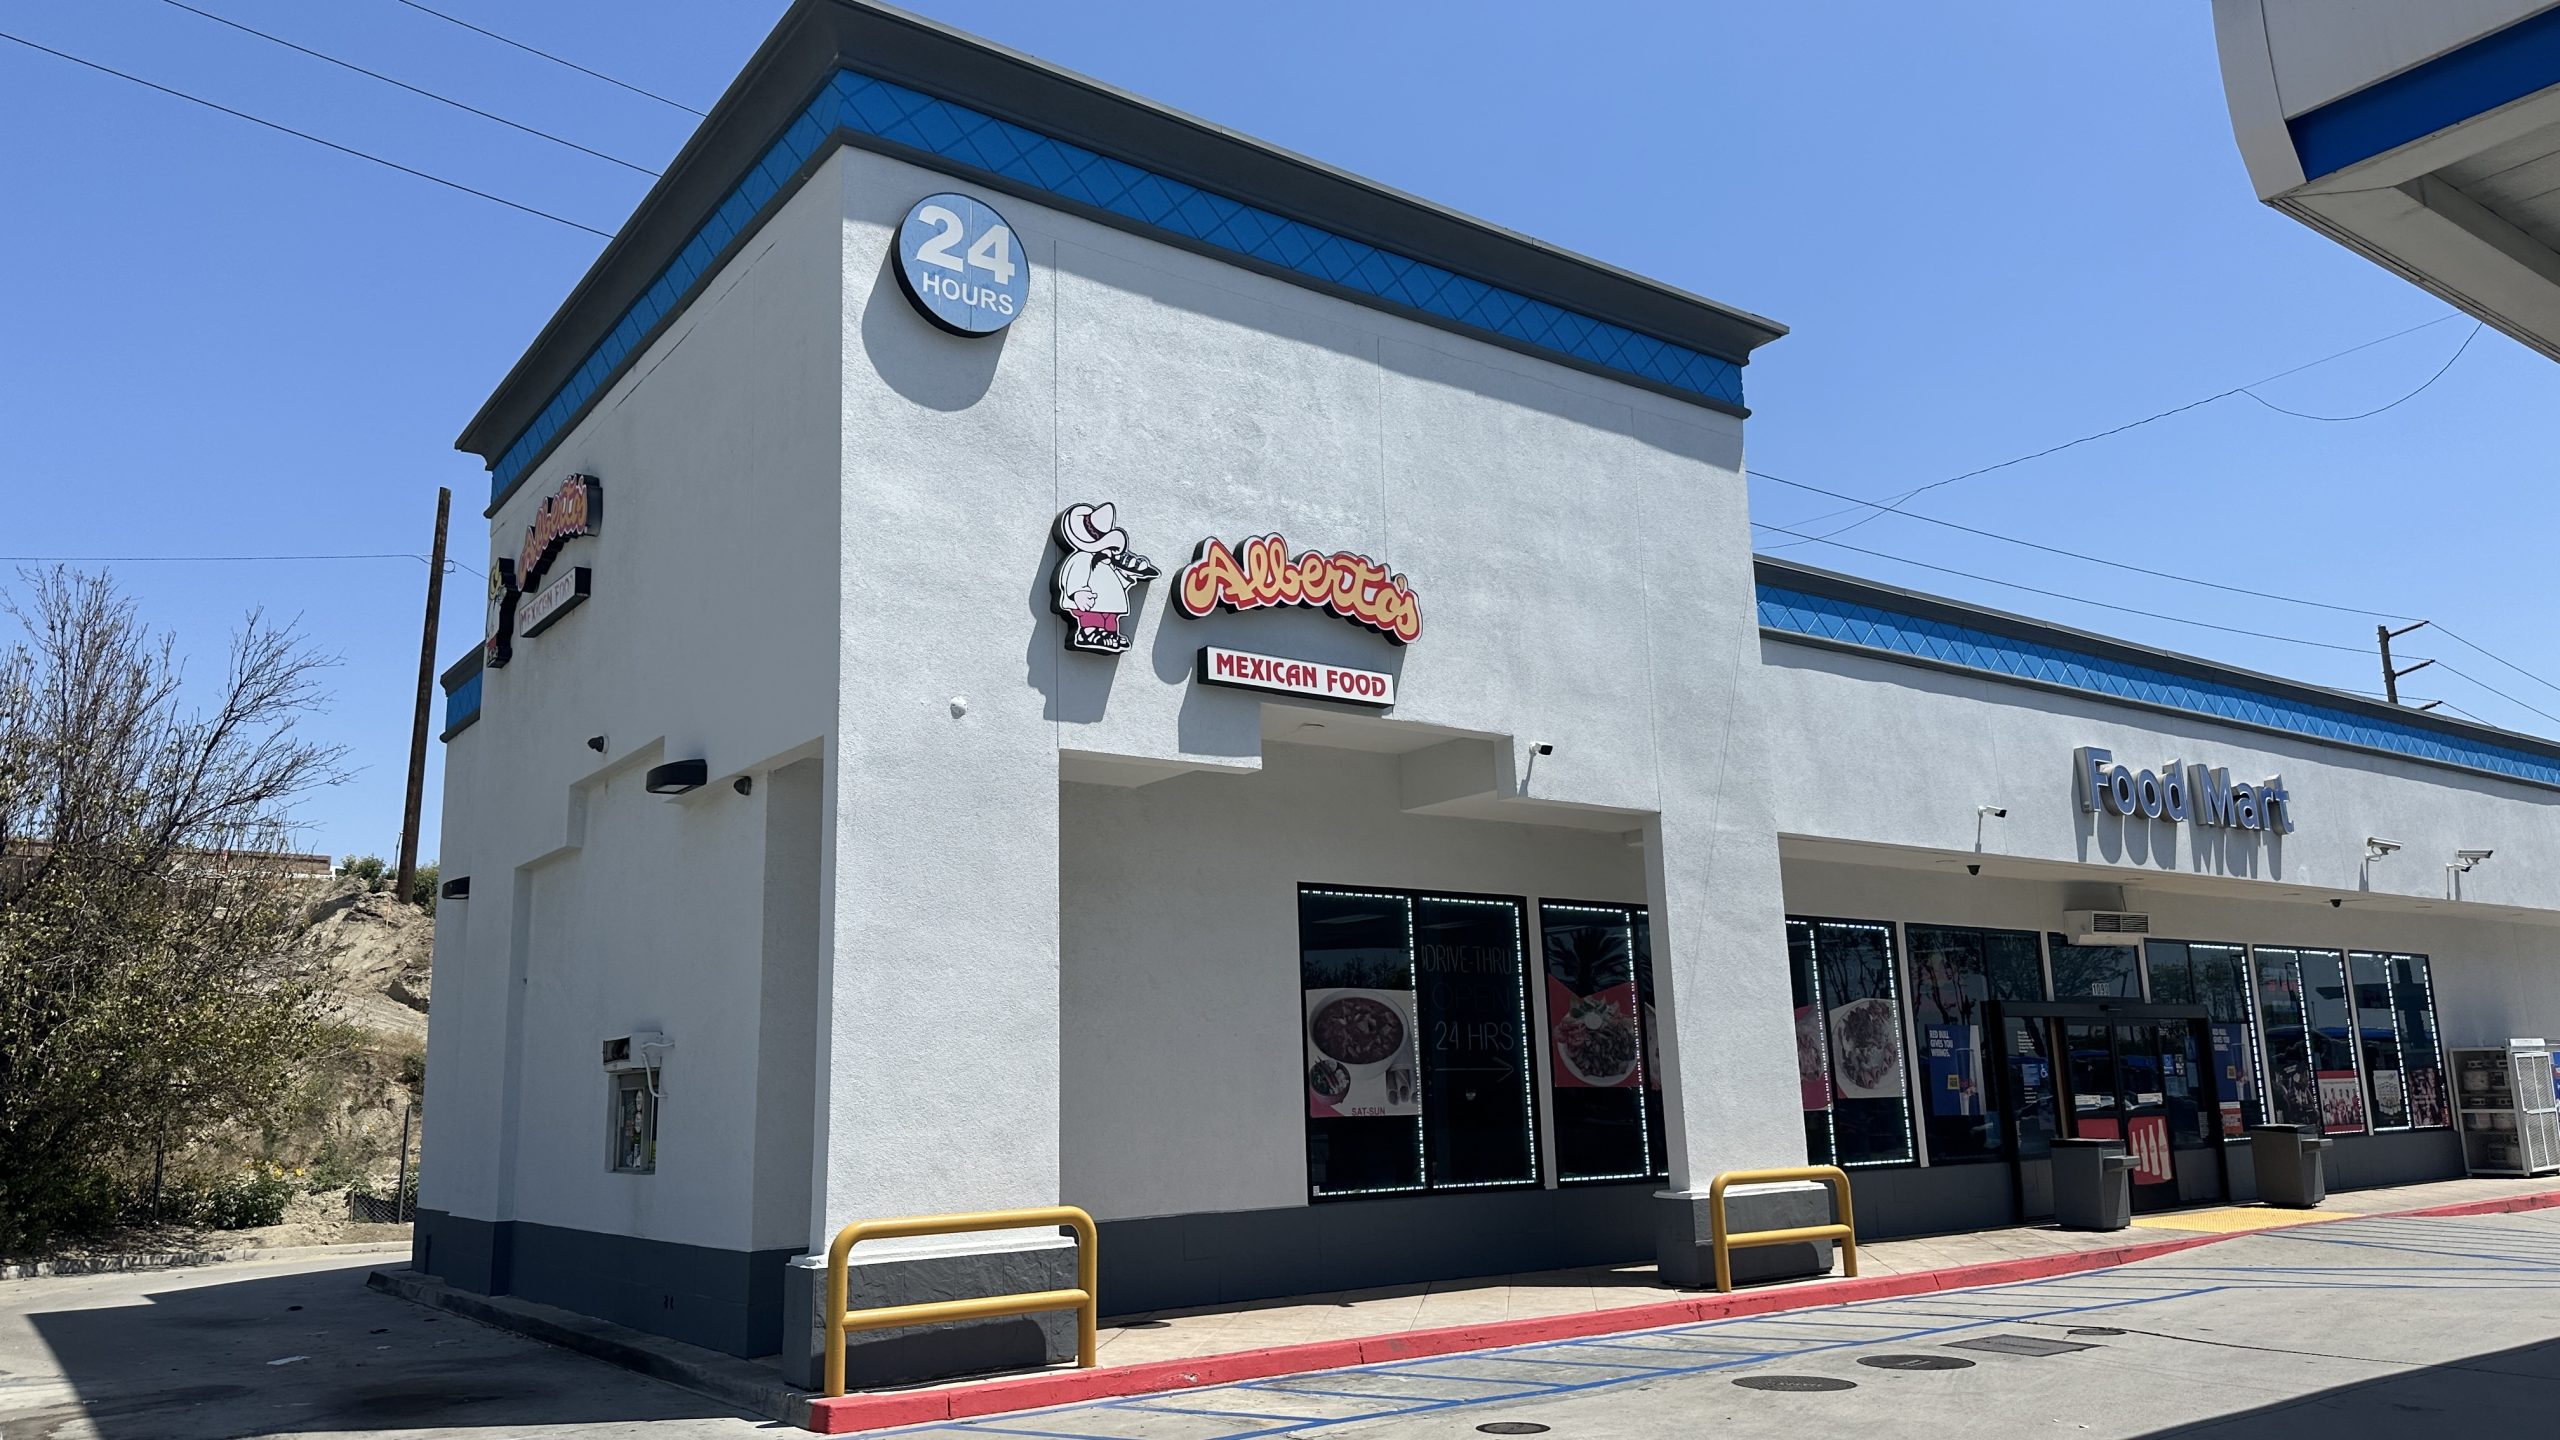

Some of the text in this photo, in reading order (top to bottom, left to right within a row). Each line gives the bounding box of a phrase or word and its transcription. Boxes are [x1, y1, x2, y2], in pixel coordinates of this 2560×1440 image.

[914, 205, 1015, 285] 24
[922, 271, 1014, 315] HOURS
[518, 475, 588, 592] Alberto's
[1183, 536, 1422, 642] Alberto's
[1216, 652, 1386, 697] MEXICAN FOOD
[2081, 746, 2295, 835] Food Mart
[1421, 944, 1511, 975] DRIVE-THRU
[1434, 1020, 1514, 1051] 24 HRS
[1351, 1107, 1385, 1116] SAT-SUN
